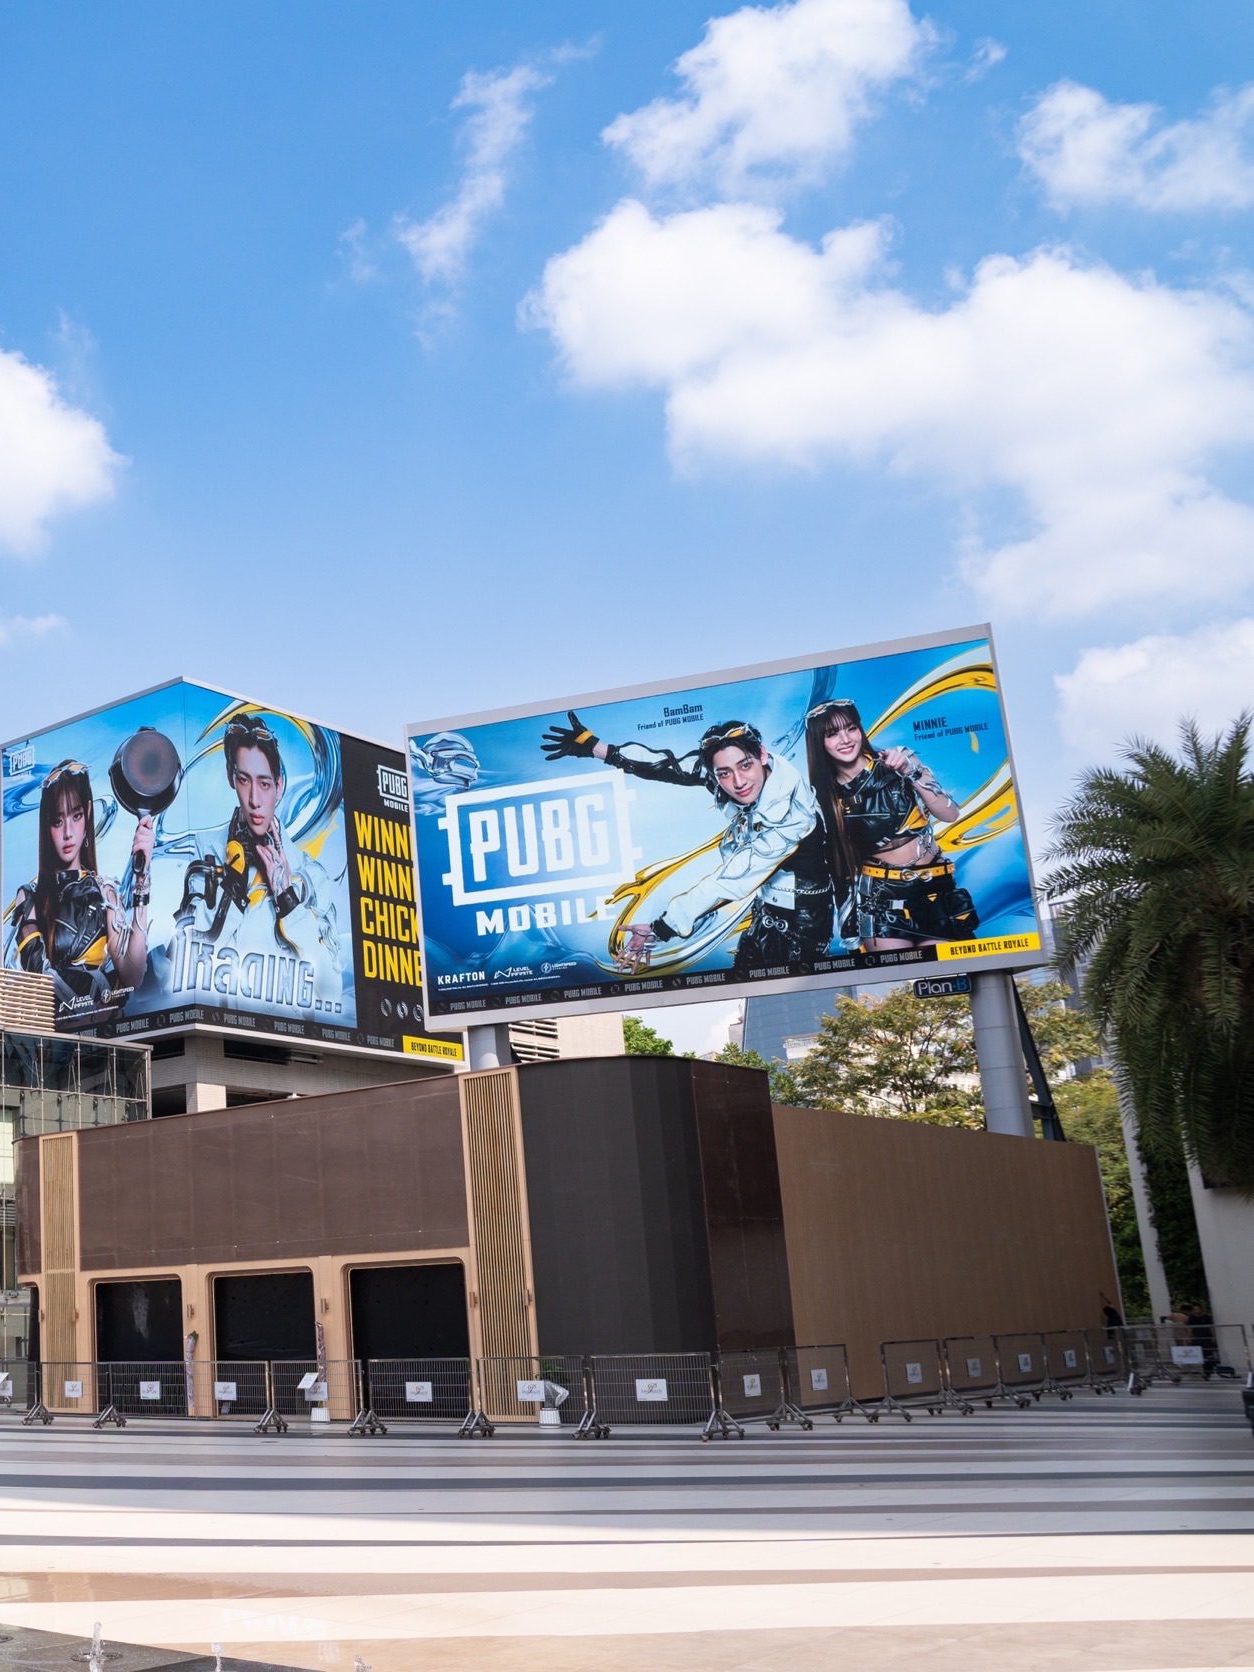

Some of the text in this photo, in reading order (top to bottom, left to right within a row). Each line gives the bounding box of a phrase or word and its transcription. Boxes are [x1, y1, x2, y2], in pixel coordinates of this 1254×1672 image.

[663, 704, 703, 718] BamBam
[637, 714, 703, 731] Friend of PUBG MOBILE
[913, 717, 948, 732] MINNIE
[914, 722, 988, 741] Friend of PUBG MOBILE
[382, 771, 408, 798] PUBG
[384, 799, 409, 813] MOBILE
[469, 794, 611, 883] PUBG
[475, 894, 617, 936] MOBILE
[949, 938, 1029, 956] BEYOND BATTLE ROYALE
[880, 950, 923, 963] PUBG MOBILE
[814, 958, 855, 971] PUBG MOBILE
[437, 971, 486, 985] KRAFTON
[686, 973, 725, 985] PUBG MOBILE
[749, 966, 790, 979] PUBG MOBILE
[564, 987, 602, 998] PUBG MOBILE
[624, 980, 663, 992] PUBG MOBILE
[450, 1000, 486, 1011] PUBG MOBILE
[505, 993, 542, 1005] PUBG MOBILE
[169, 1009, 204, 1023] PUBG MOBILE
[223, 1013, 256, 1028] PUBG MOBILE
[116, 1018, 149, 1033] PUBG MOBILE
[274, 1021, 305, 1035] PUBG MOBILE
[321, 1028, 351, 1041] PUBG MOBILE
[367, 1035, 394, 1047] PUBG MOBILE
[411, 1041, 457, 1057] BEYOND BATTLE ROYALE
